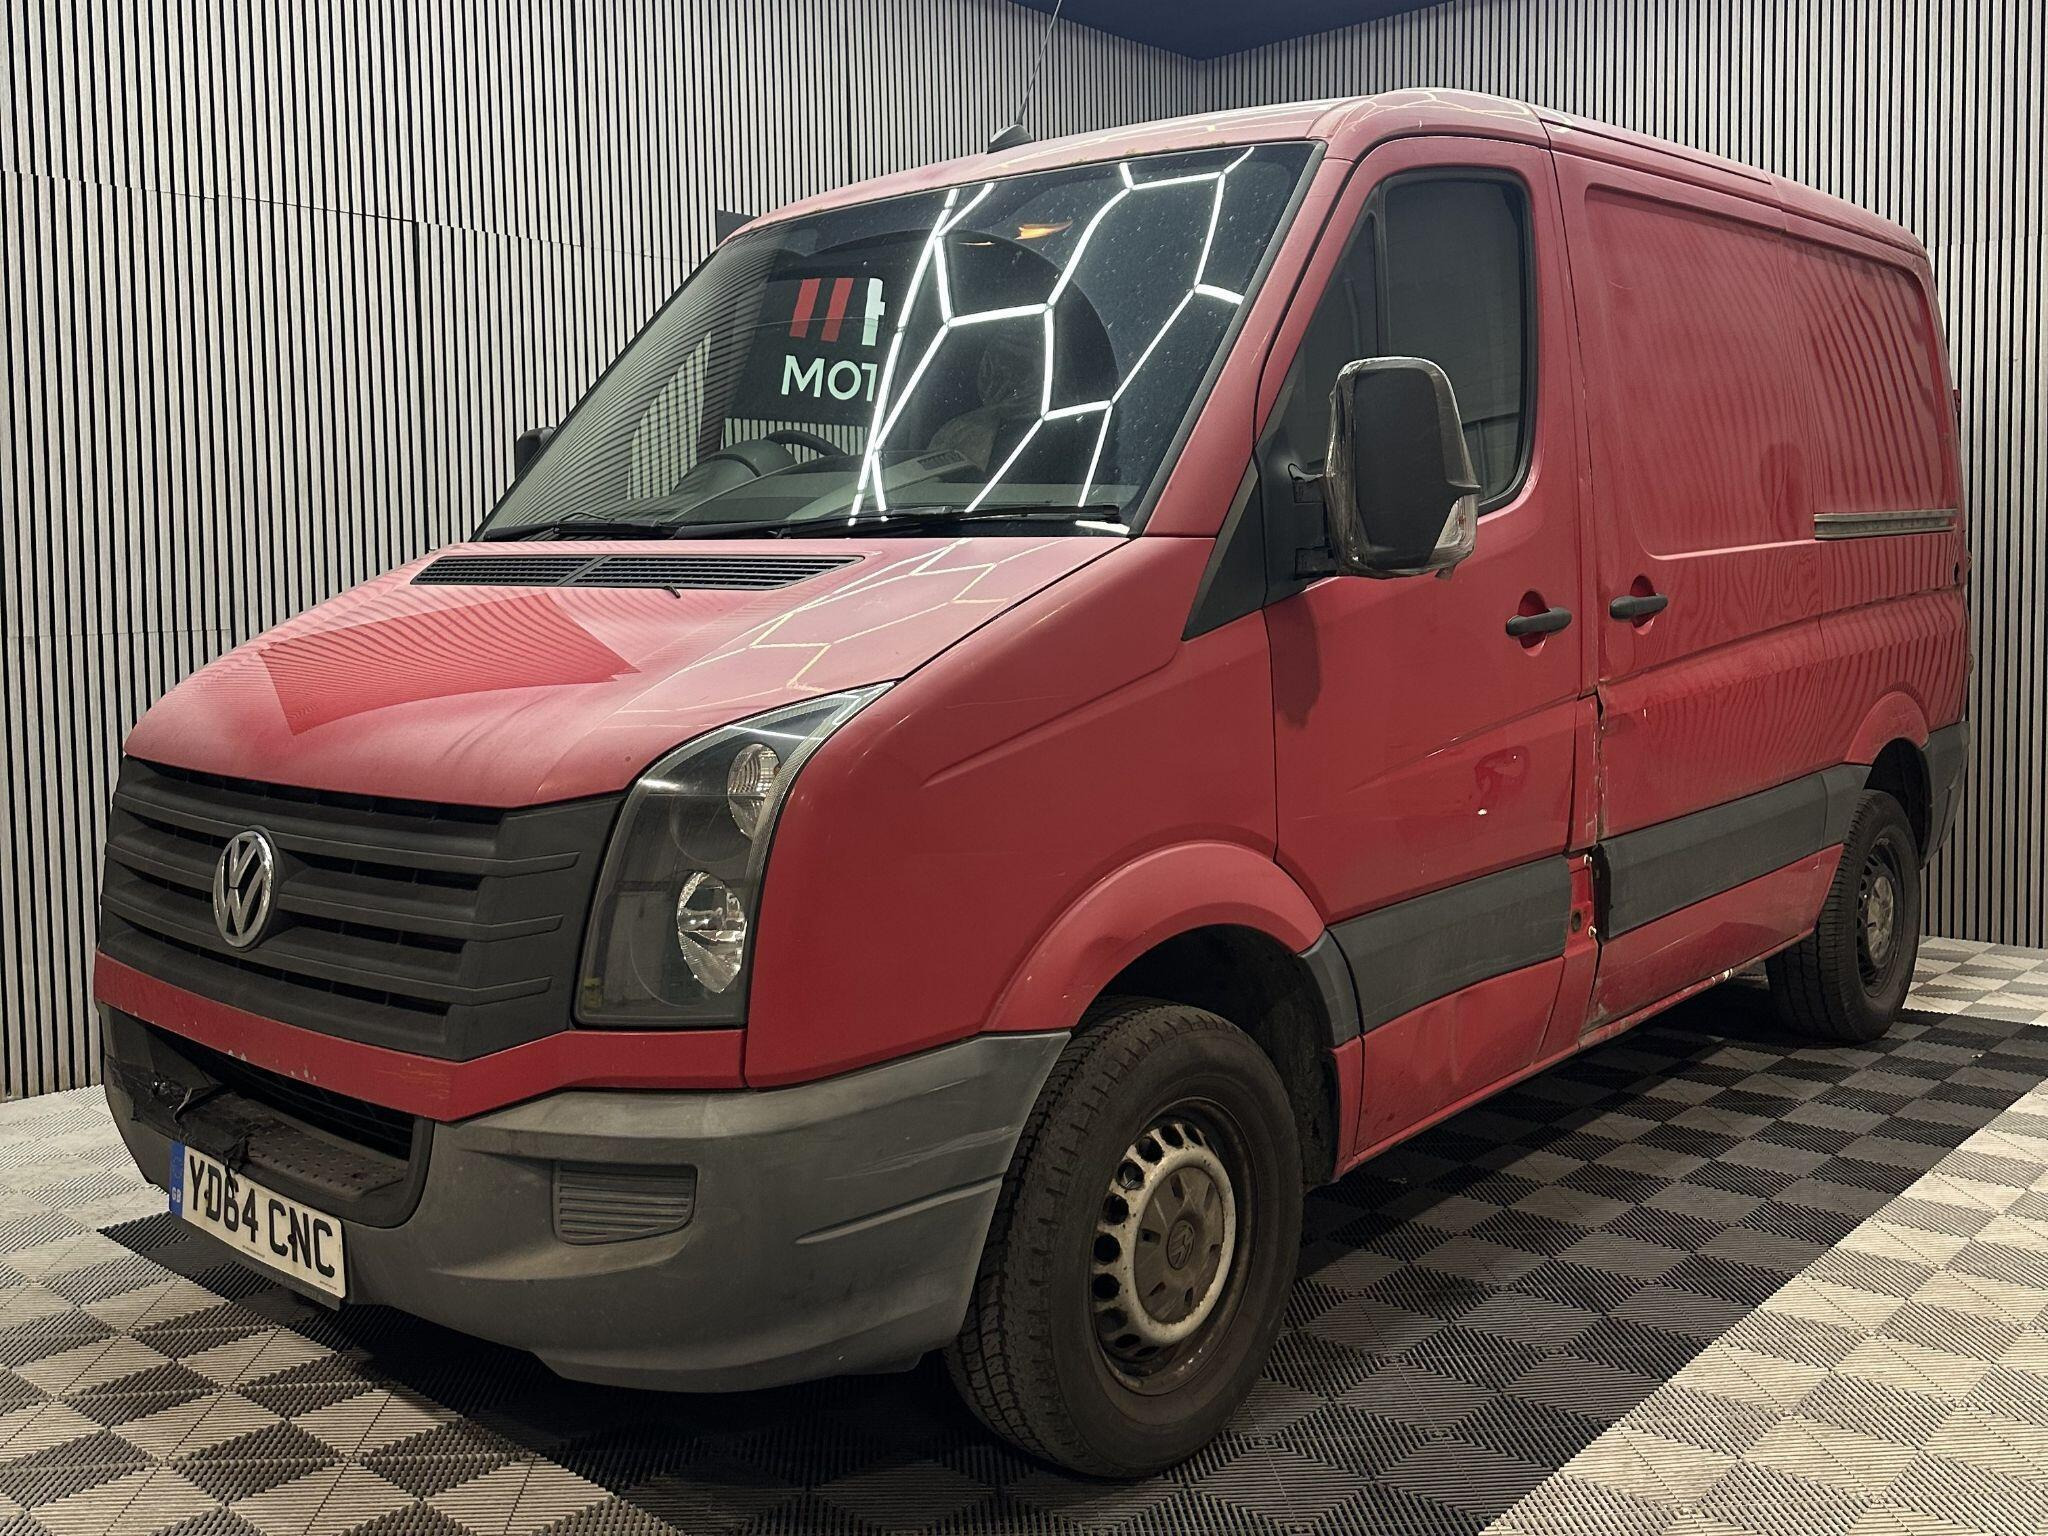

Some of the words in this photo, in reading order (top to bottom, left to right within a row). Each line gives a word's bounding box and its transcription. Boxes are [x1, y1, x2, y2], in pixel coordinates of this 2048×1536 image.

[218, 833, 269, 943] VW
[171, 1186, 181, 1203] GB
[190, 1155, 259, 1243] YD64
[268, 1198, 335, 1278] CNC
